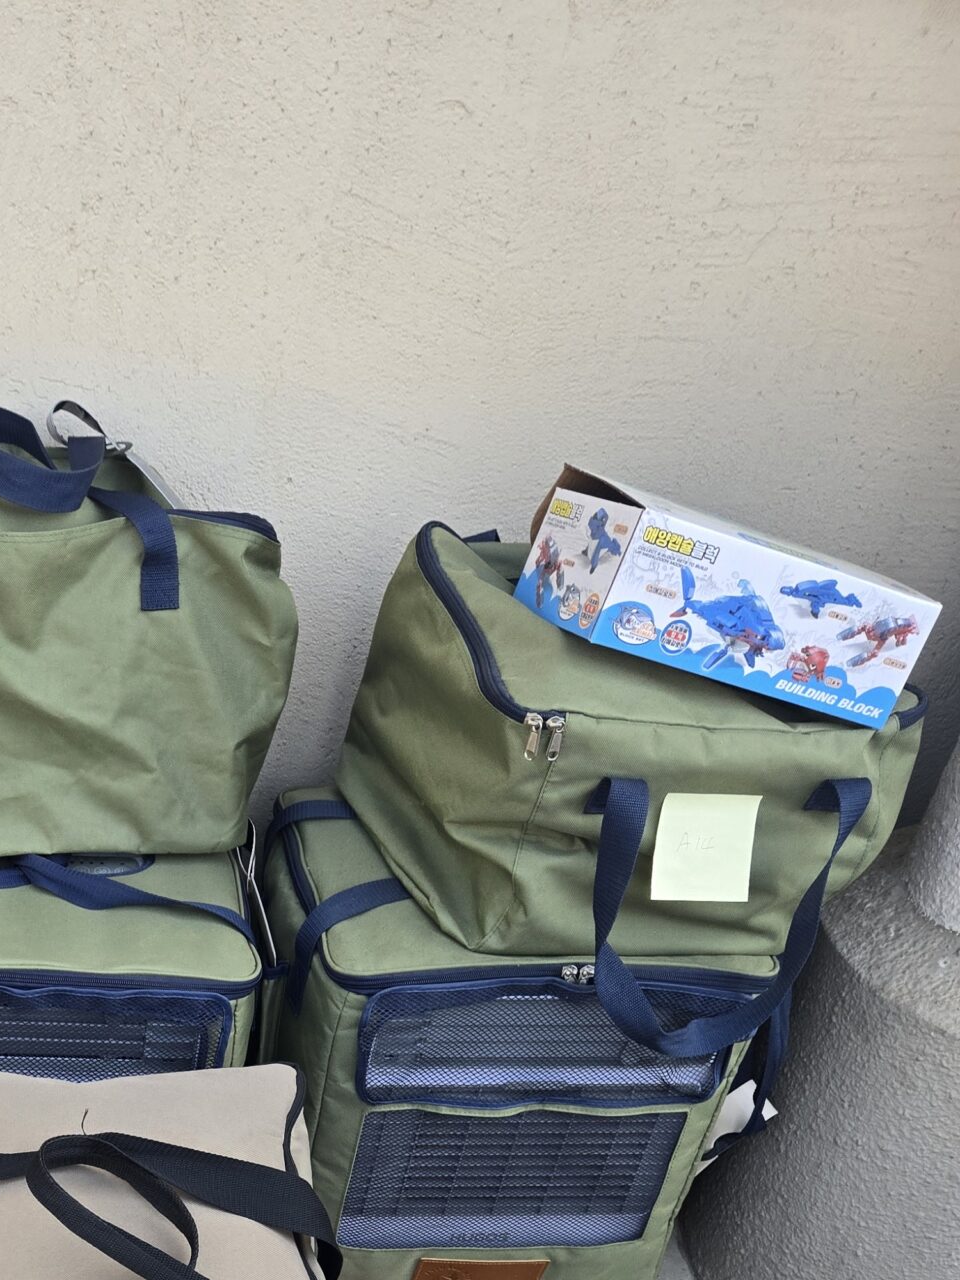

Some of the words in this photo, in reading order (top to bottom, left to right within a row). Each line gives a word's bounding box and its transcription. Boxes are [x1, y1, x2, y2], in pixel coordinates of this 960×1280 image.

[643, 525, 721, 565] 해양캡슐블럭
[775, 679, 839, 706] BUILDING
[837, 698, 884, 719] BLOCK
